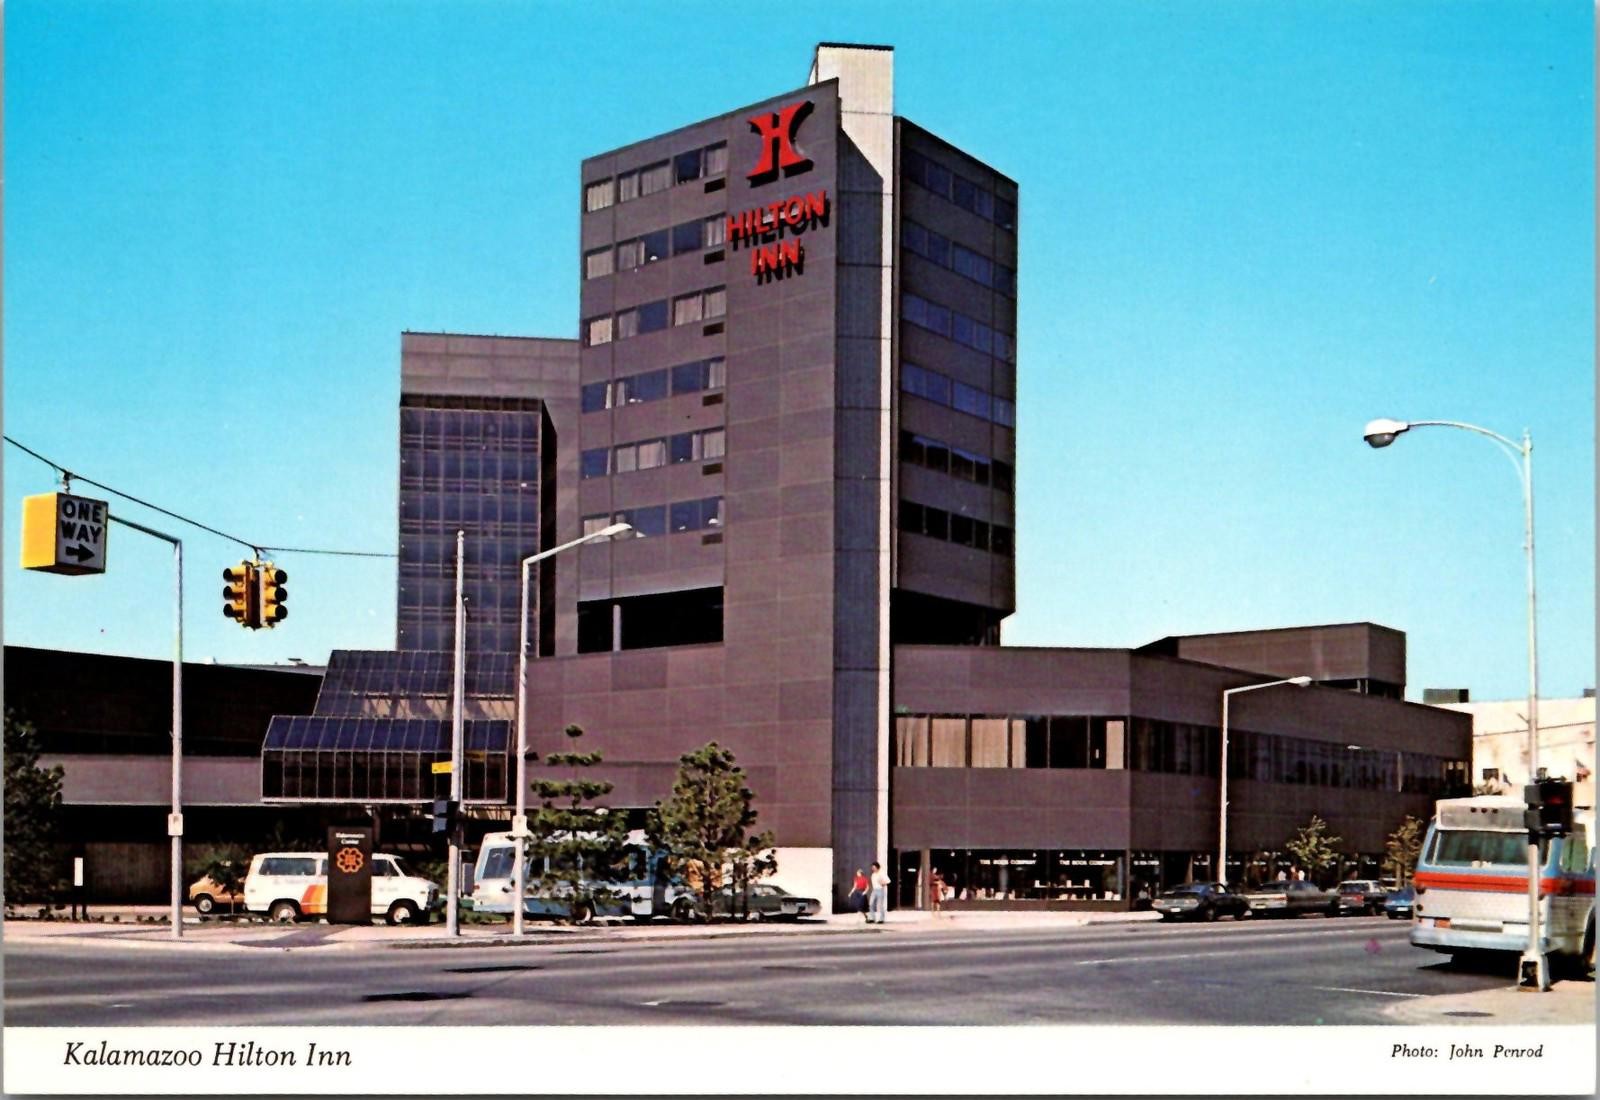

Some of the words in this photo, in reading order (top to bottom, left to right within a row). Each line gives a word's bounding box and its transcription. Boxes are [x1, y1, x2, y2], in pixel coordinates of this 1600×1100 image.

[746, 100, 806, 180] H
[726, 190, 827, 242] HILTON
[751, 238, 801, 277] INN
[62, 500, 102, 523] ONE
[61, 520, 103, 543] WAY
